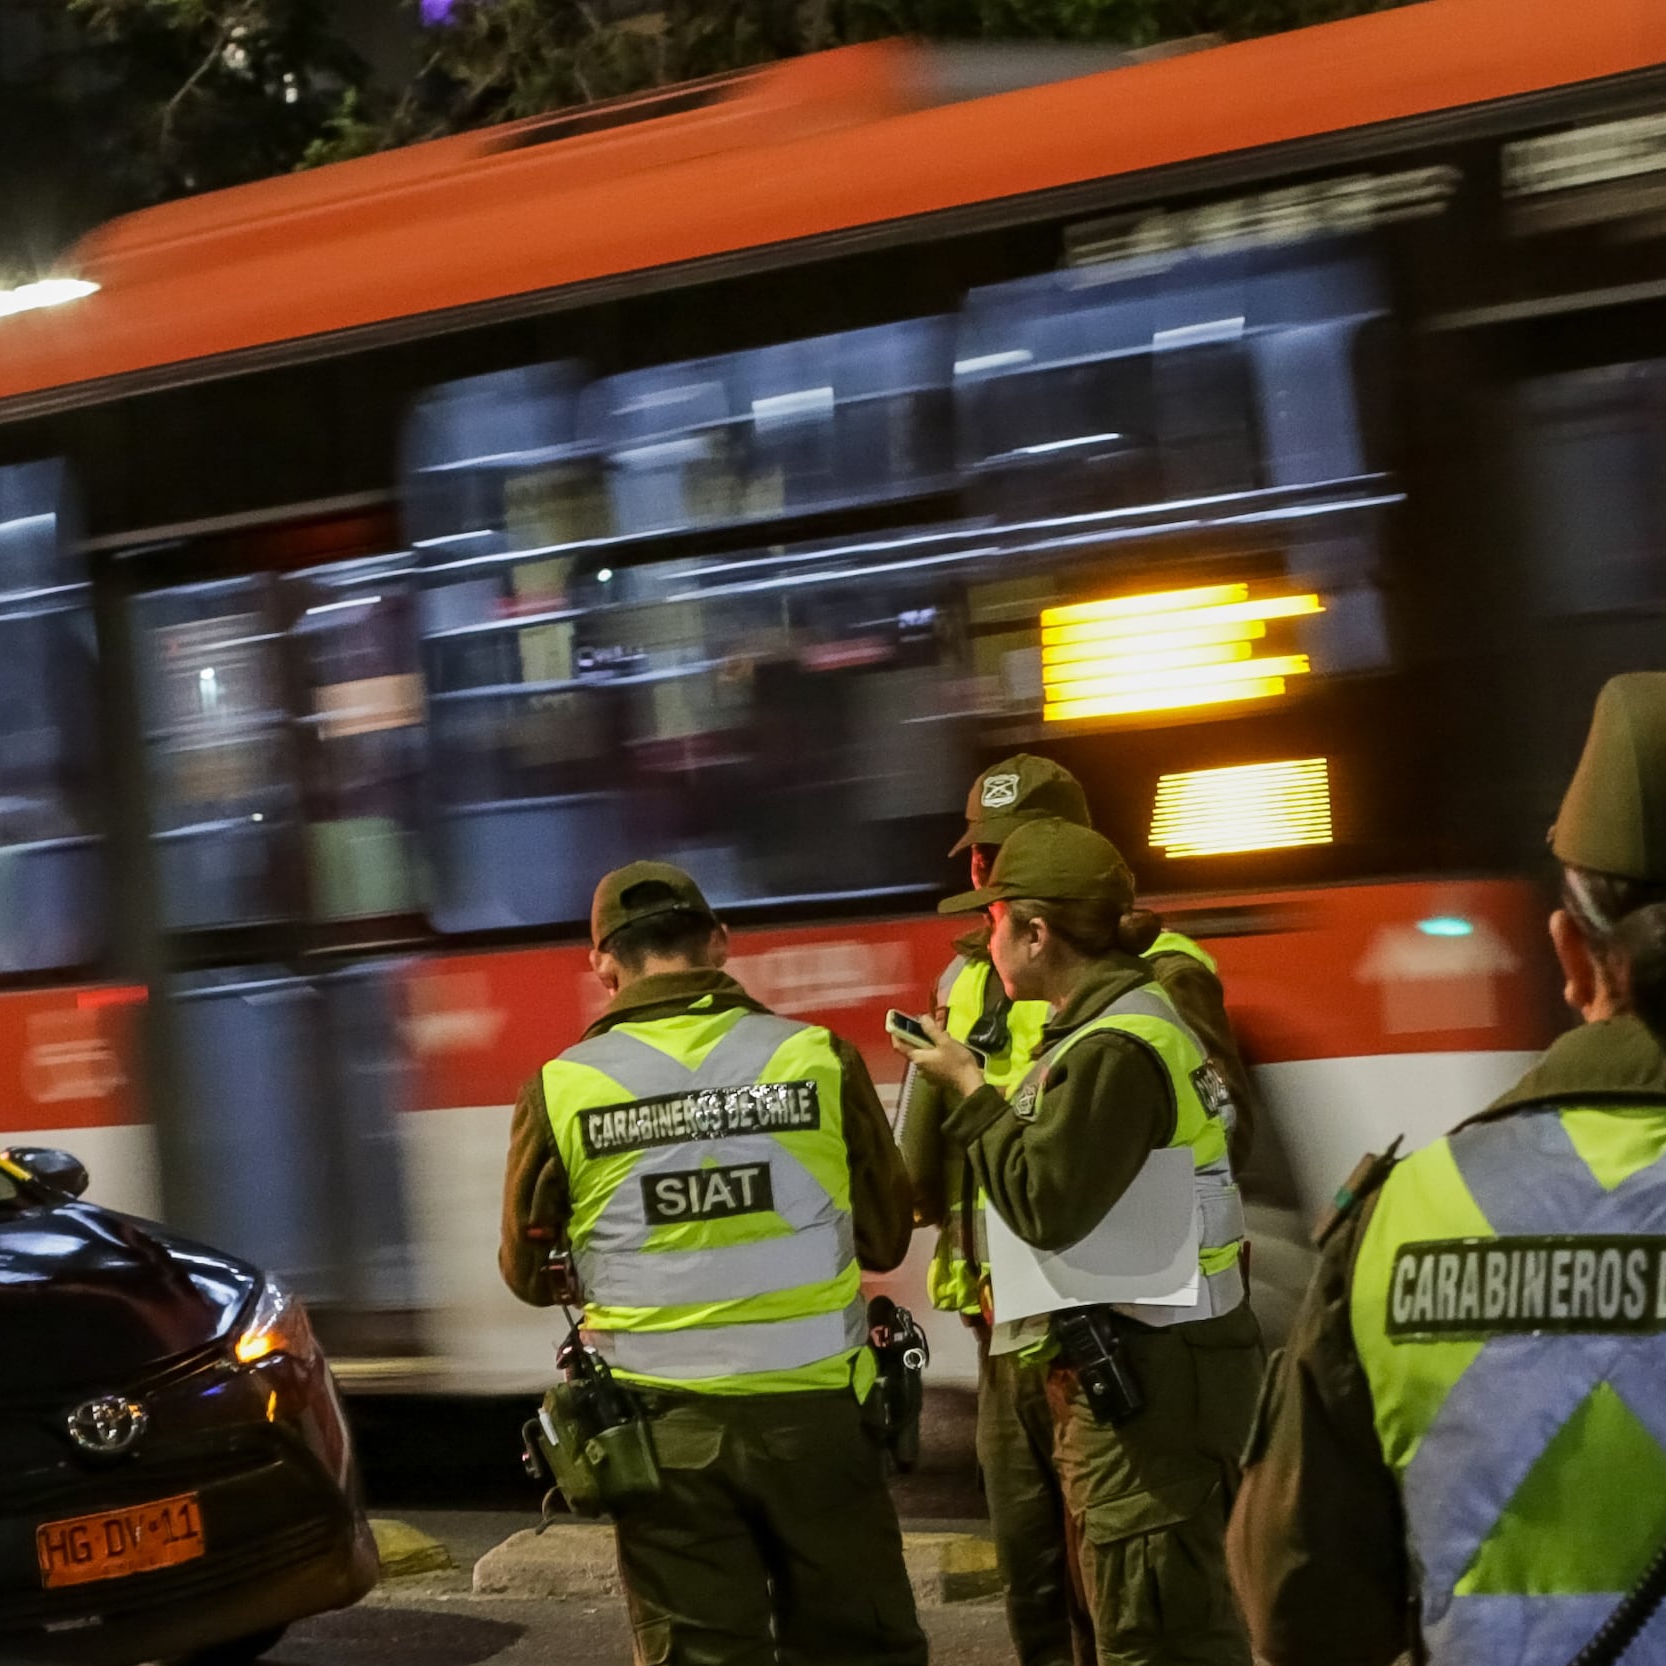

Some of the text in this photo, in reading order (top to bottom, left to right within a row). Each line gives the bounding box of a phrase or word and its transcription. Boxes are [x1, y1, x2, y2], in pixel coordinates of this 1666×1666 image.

[589, 1087, 812, 1149] CARABINEROS DE CHILE
[655, 1168, 760, 1216] SIAT
[1393, 1248, 1648, 1324] CARABINEROS
